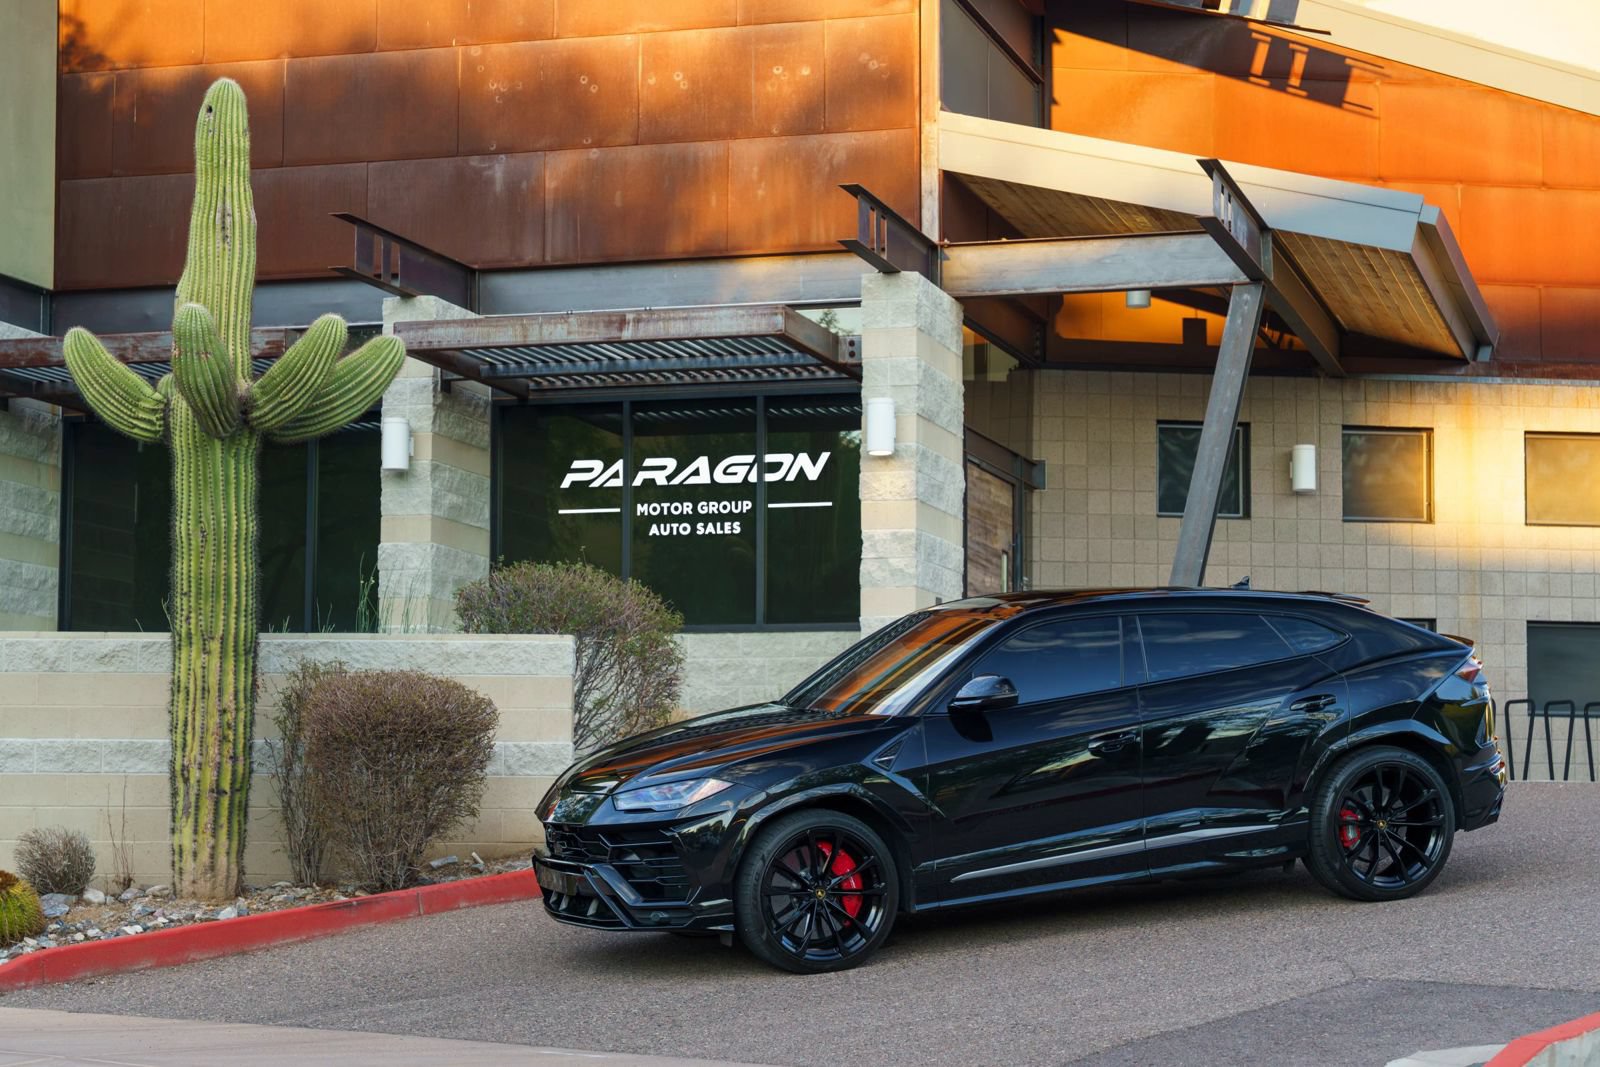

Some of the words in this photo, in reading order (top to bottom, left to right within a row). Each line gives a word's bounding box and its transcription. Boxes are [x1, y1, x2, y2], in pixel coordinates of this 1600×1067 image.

[560, 452, 830, 488] PARAGON
[636, 502, 692, 516] MOTOR
[697, 500, 753, 514] GROUP
[648, 523, 692, 536] AUTO
[697, 522, 741, 535] SALES
